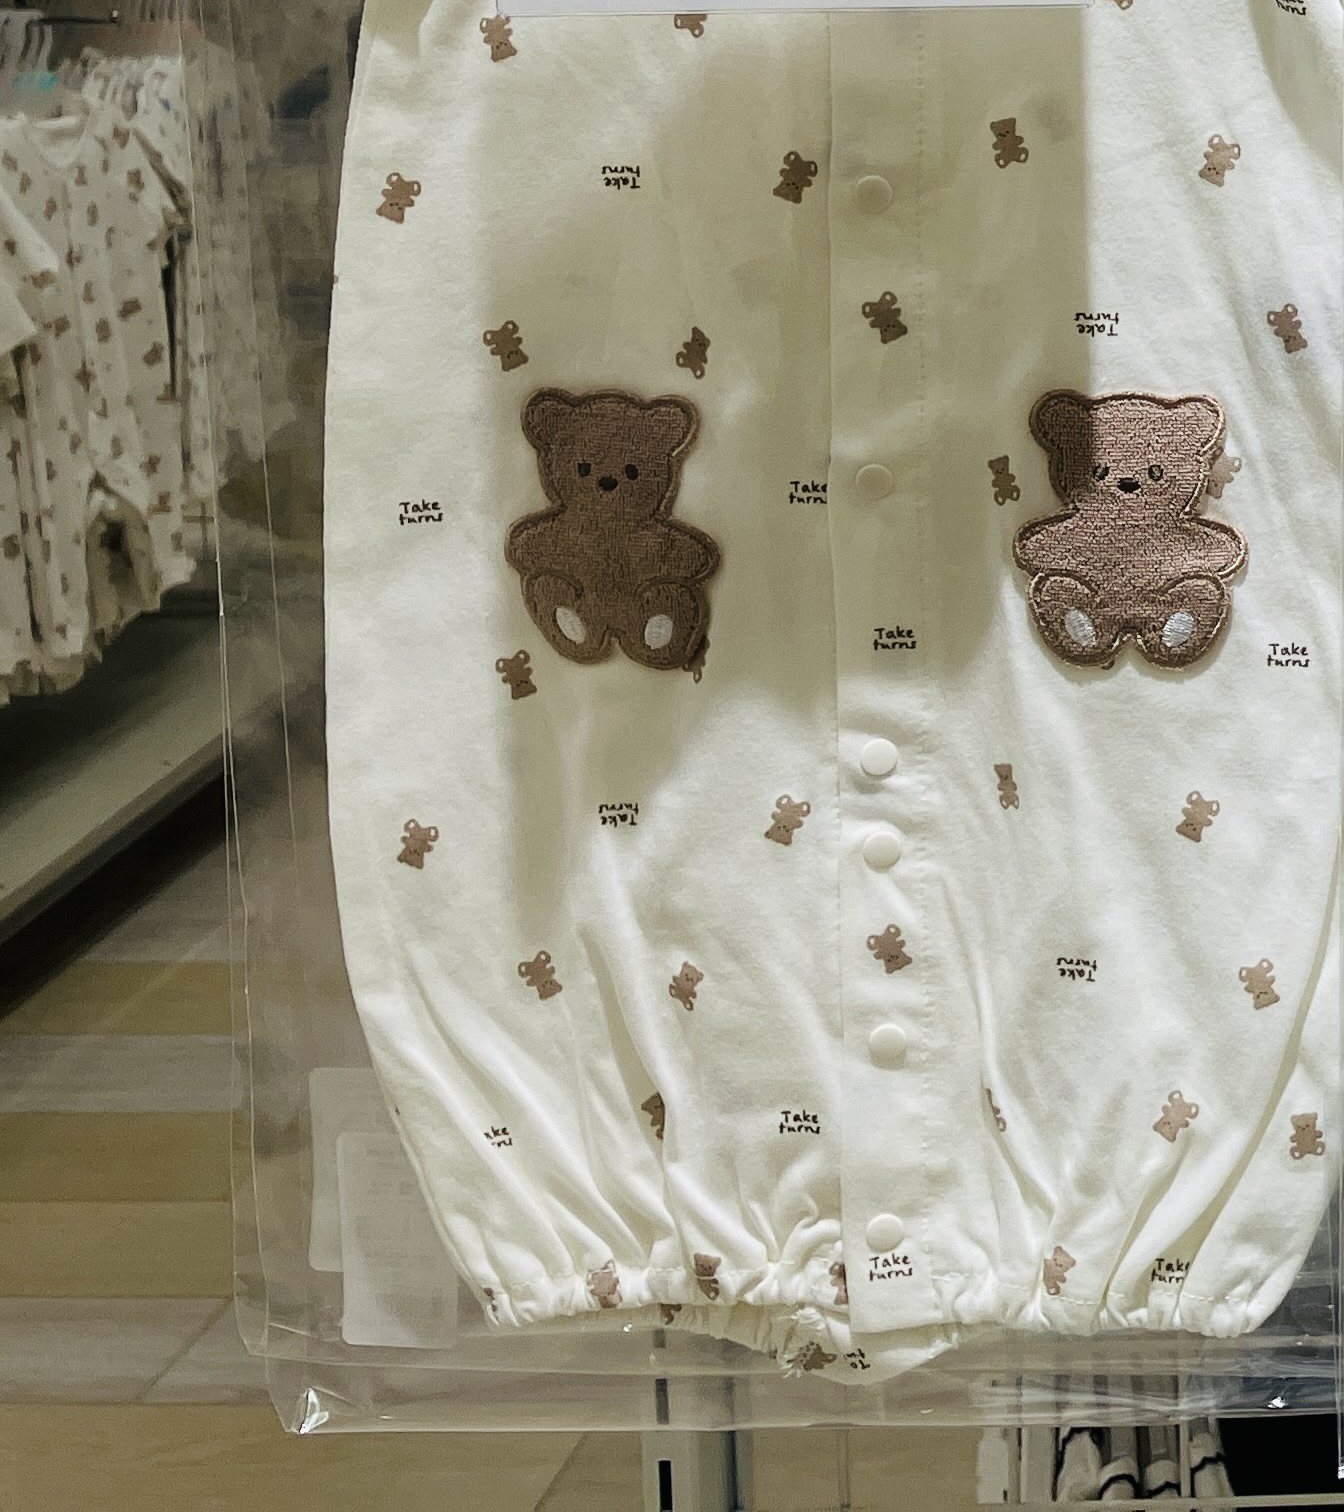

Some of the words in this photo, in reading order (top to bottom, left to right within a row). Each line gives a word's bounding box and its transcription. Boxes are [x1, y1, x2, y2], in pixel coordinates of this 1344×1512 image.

[601, 165, 641, 178] turns
[604, 177, 641, 190] Take
[1074, 312, 1120, 324] turns
[1075, 324, 1118, 338] Take
[399, 499, 442, 514] Take
[399, 513, 443, 525] turns
[874, 626, 915, 640] Take
[873, 639, 917, 651] turns
[1268, 642, 1309, 656] Take
[1267, 655, 1311, 668] turns
[600, 814, 637, 828] Take
[1056, 957, 1097, 972] turns
[1059, 968, 1096, 982] Take
[780, 1110, 819, 1124] Take
[778, 1122, 821, 1135] turns
[869, 1254, 911, 1270] Take
[868, 1268, 913, 1282] turns
